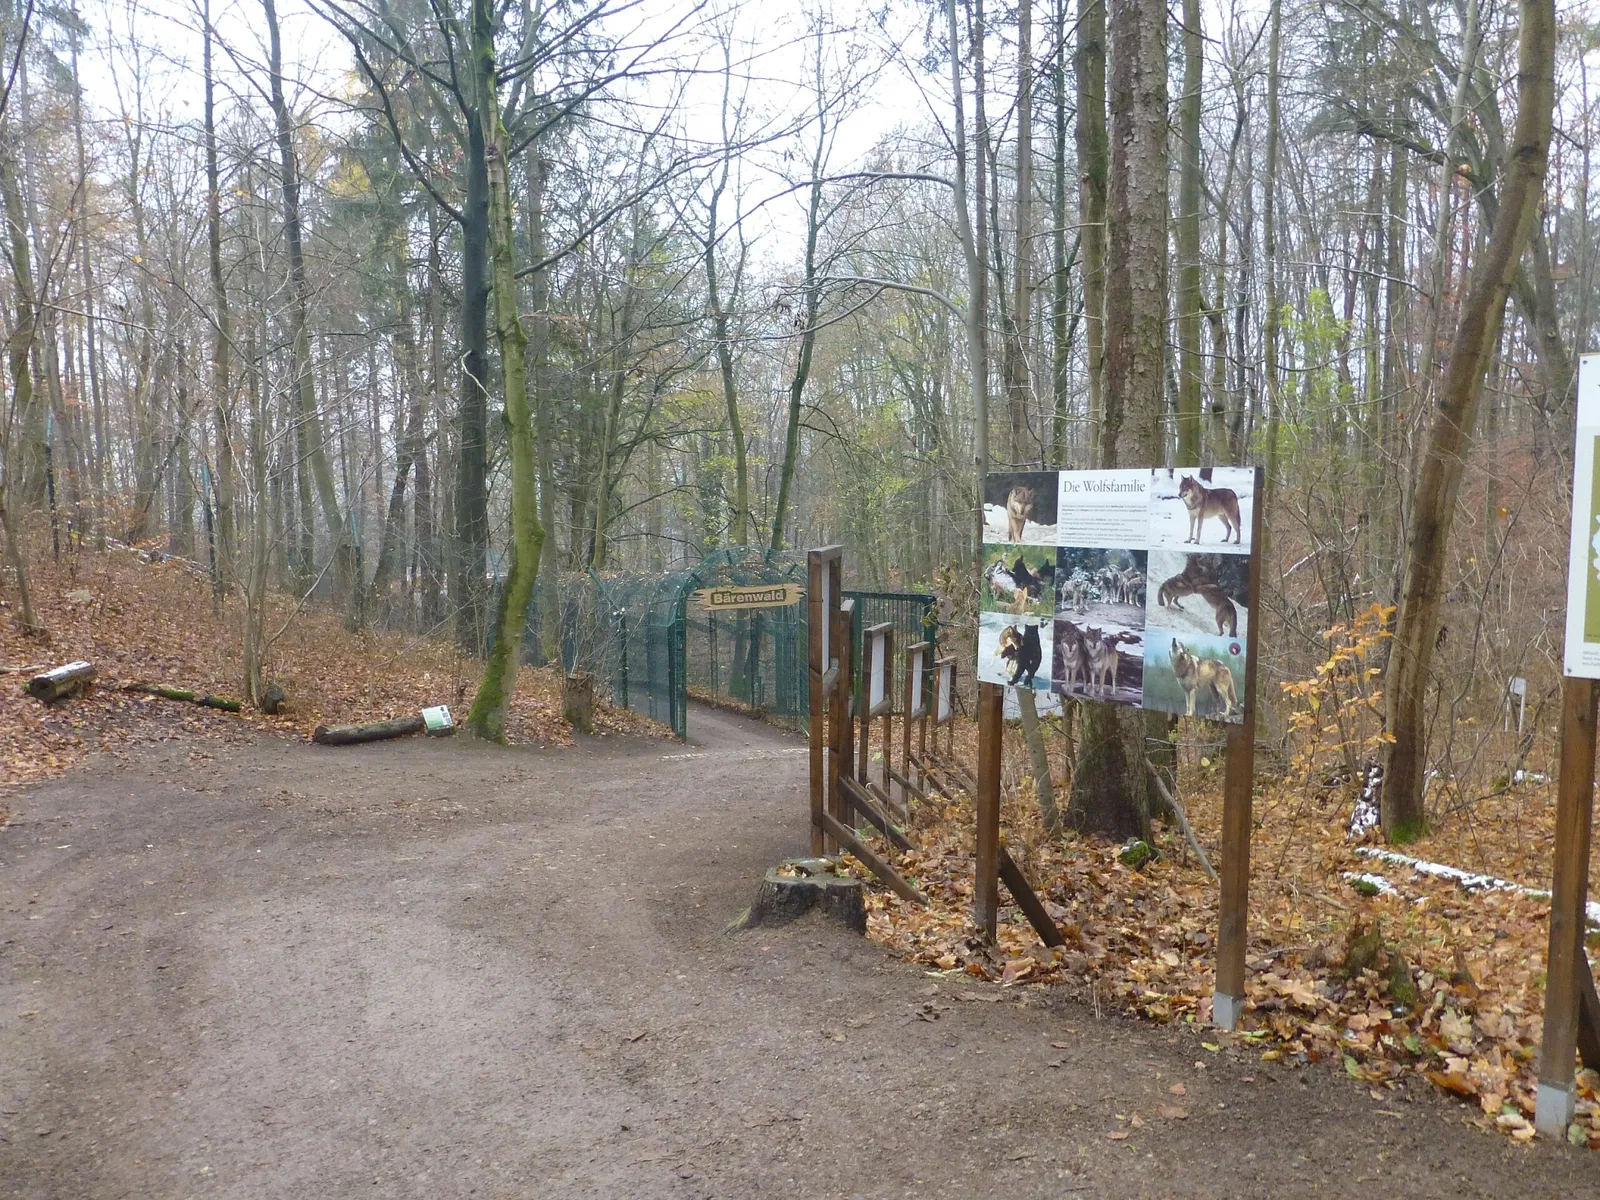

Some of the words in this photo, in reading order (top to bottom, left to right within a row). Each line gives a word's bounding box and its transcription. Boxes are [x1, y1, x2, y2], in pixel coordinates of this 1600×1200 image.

[1063, 480, 1080, 493] Die
[1083, 479, 1146, 493] Wolfsfamilie
[713, 589, 784, 604] Bärenwald
